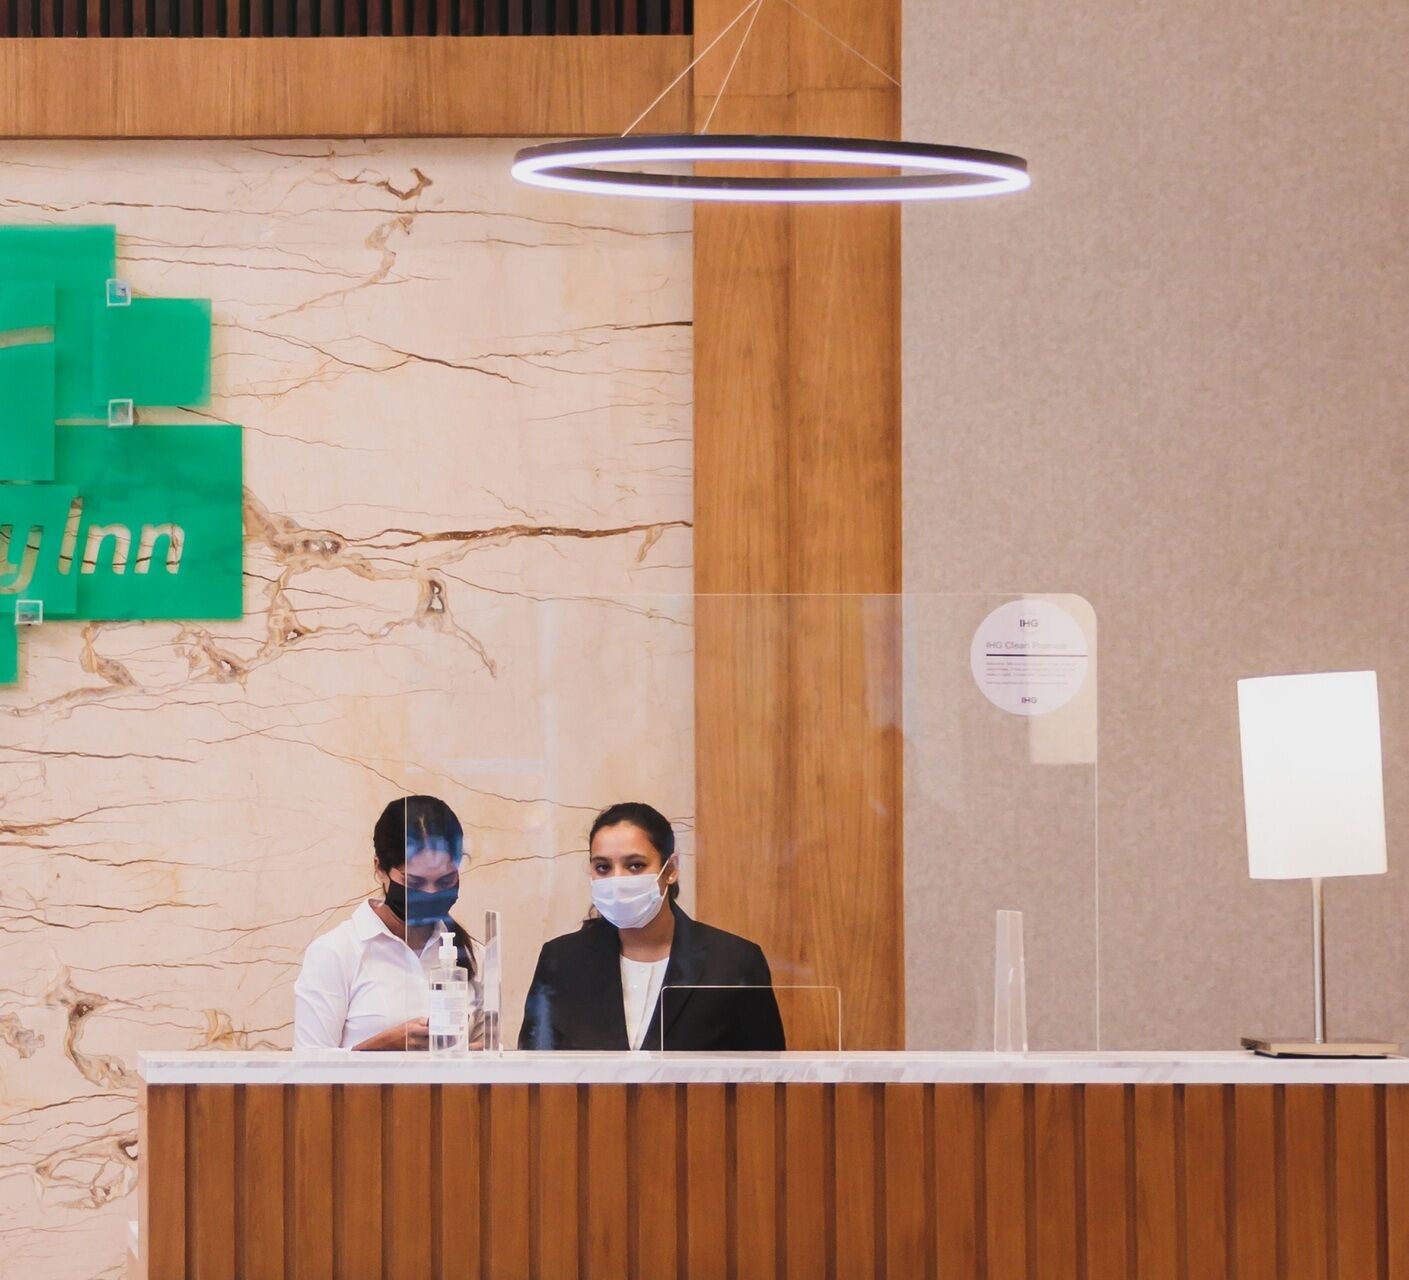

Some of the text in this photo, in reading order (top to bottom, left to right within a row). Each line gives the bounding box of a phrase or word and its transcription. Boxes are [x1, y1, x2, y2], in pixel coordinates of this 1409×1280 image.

[58, 495, 185, 575] Inn
[1019, 618, 1039, 628] IHG
[985, 641, 1003, 649] IHG
[1021, 696, 1038, 704] IHG
